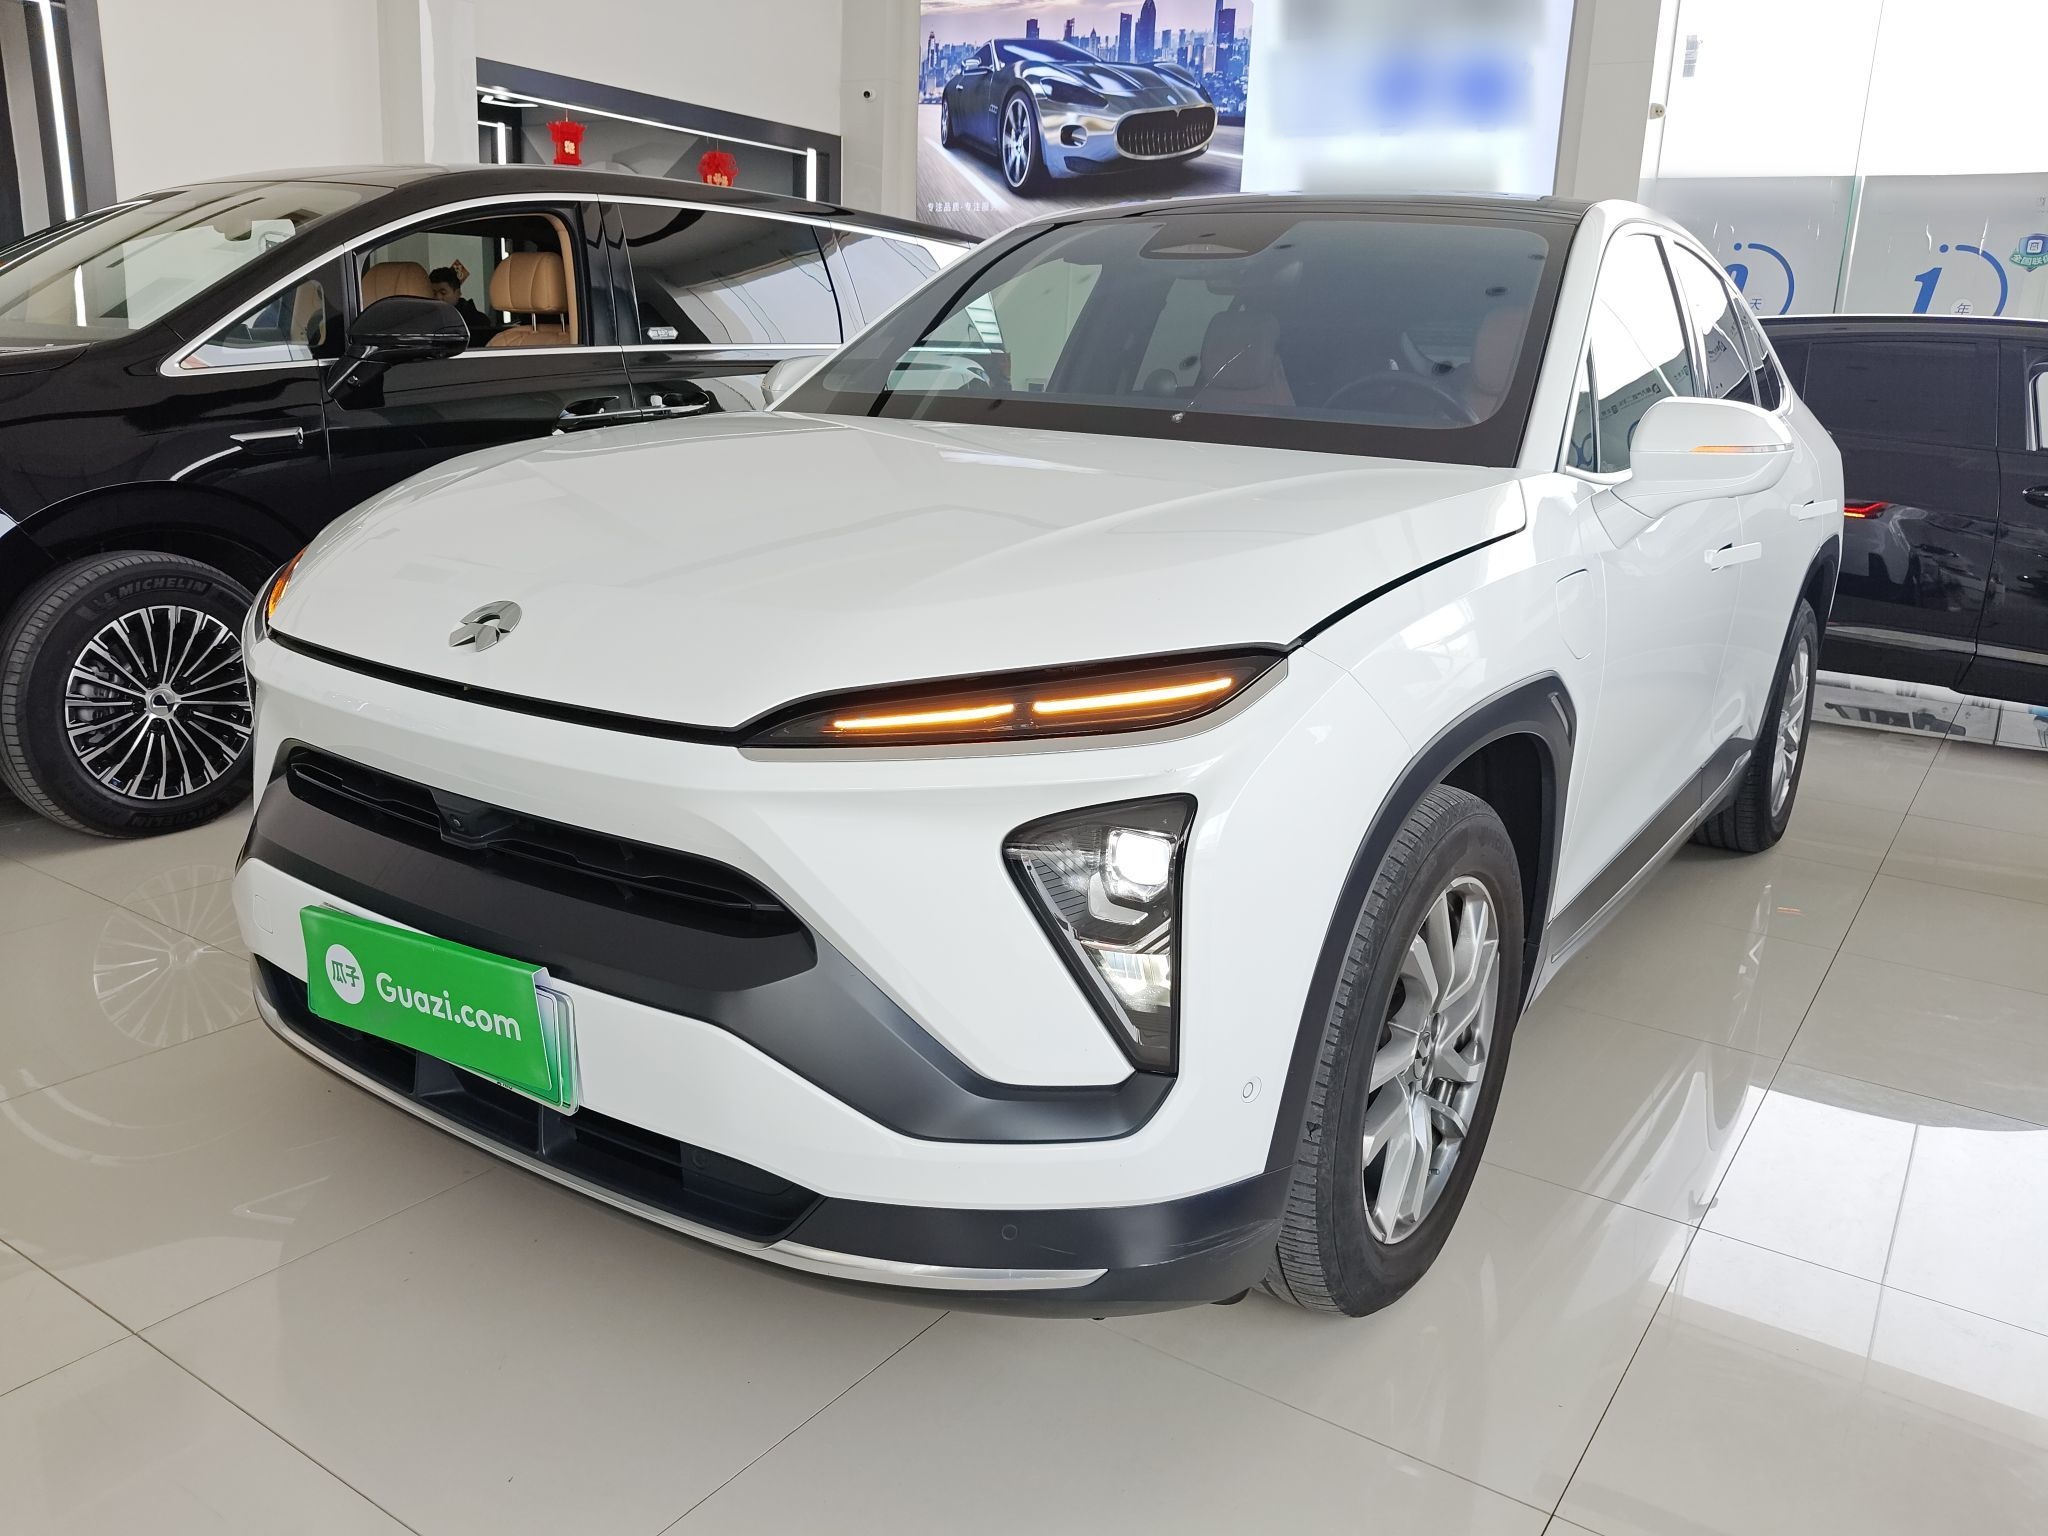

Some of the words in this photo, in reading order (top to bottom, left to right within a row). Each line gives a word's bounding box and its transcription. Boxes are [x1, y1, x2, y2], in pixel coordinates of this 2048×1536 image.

[1750, 298, 1762, 310] 天
[1955, 303, 1971, 315] 年
[118, 577, 208, 597] MICHELIN
[331, 960, 360, 987] 瓜子
[375, 972, 522, 1041] Guazi.com
